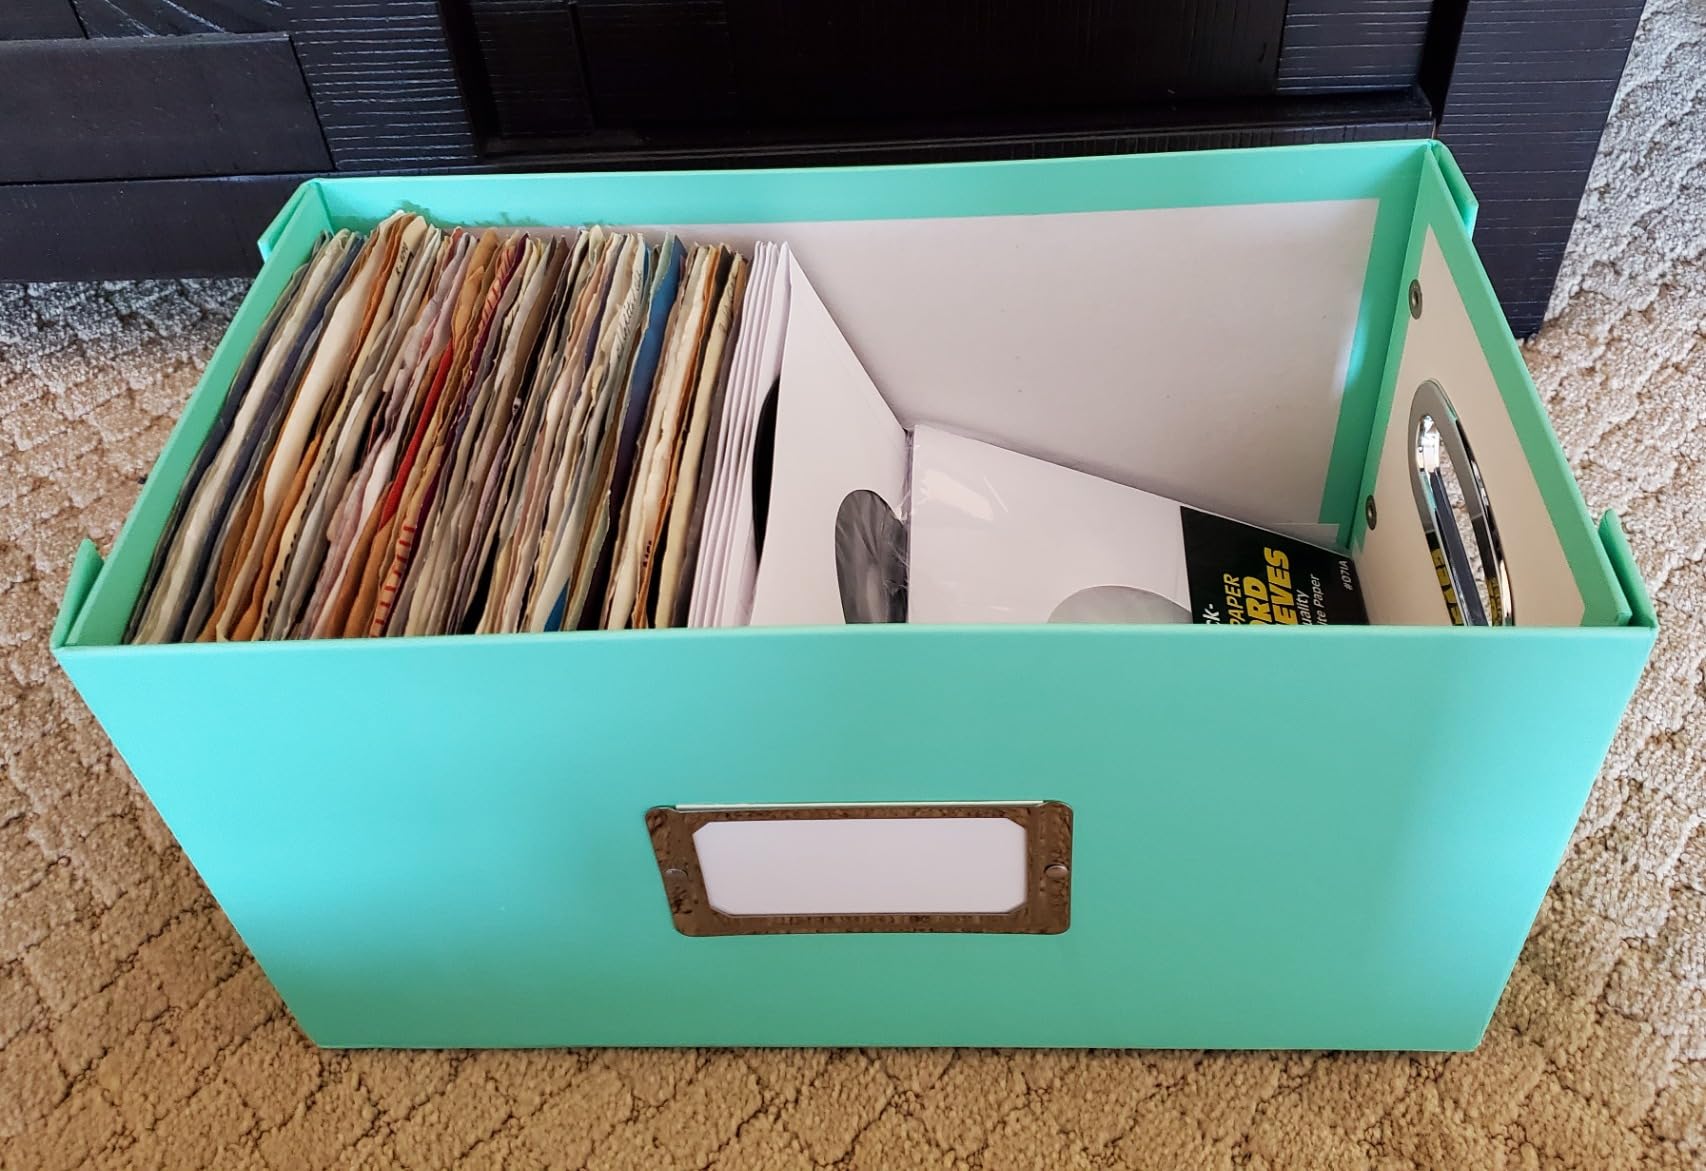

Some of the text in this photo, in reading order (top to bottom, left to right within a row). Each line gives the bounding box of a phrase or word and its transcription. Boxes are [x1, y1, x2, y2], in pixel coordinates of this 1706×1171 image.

[1223, 573, 1246, 624] PAPER
[1264, 546, 1299, 625] EVES
[1310, 573, 1325, 609] Paper
